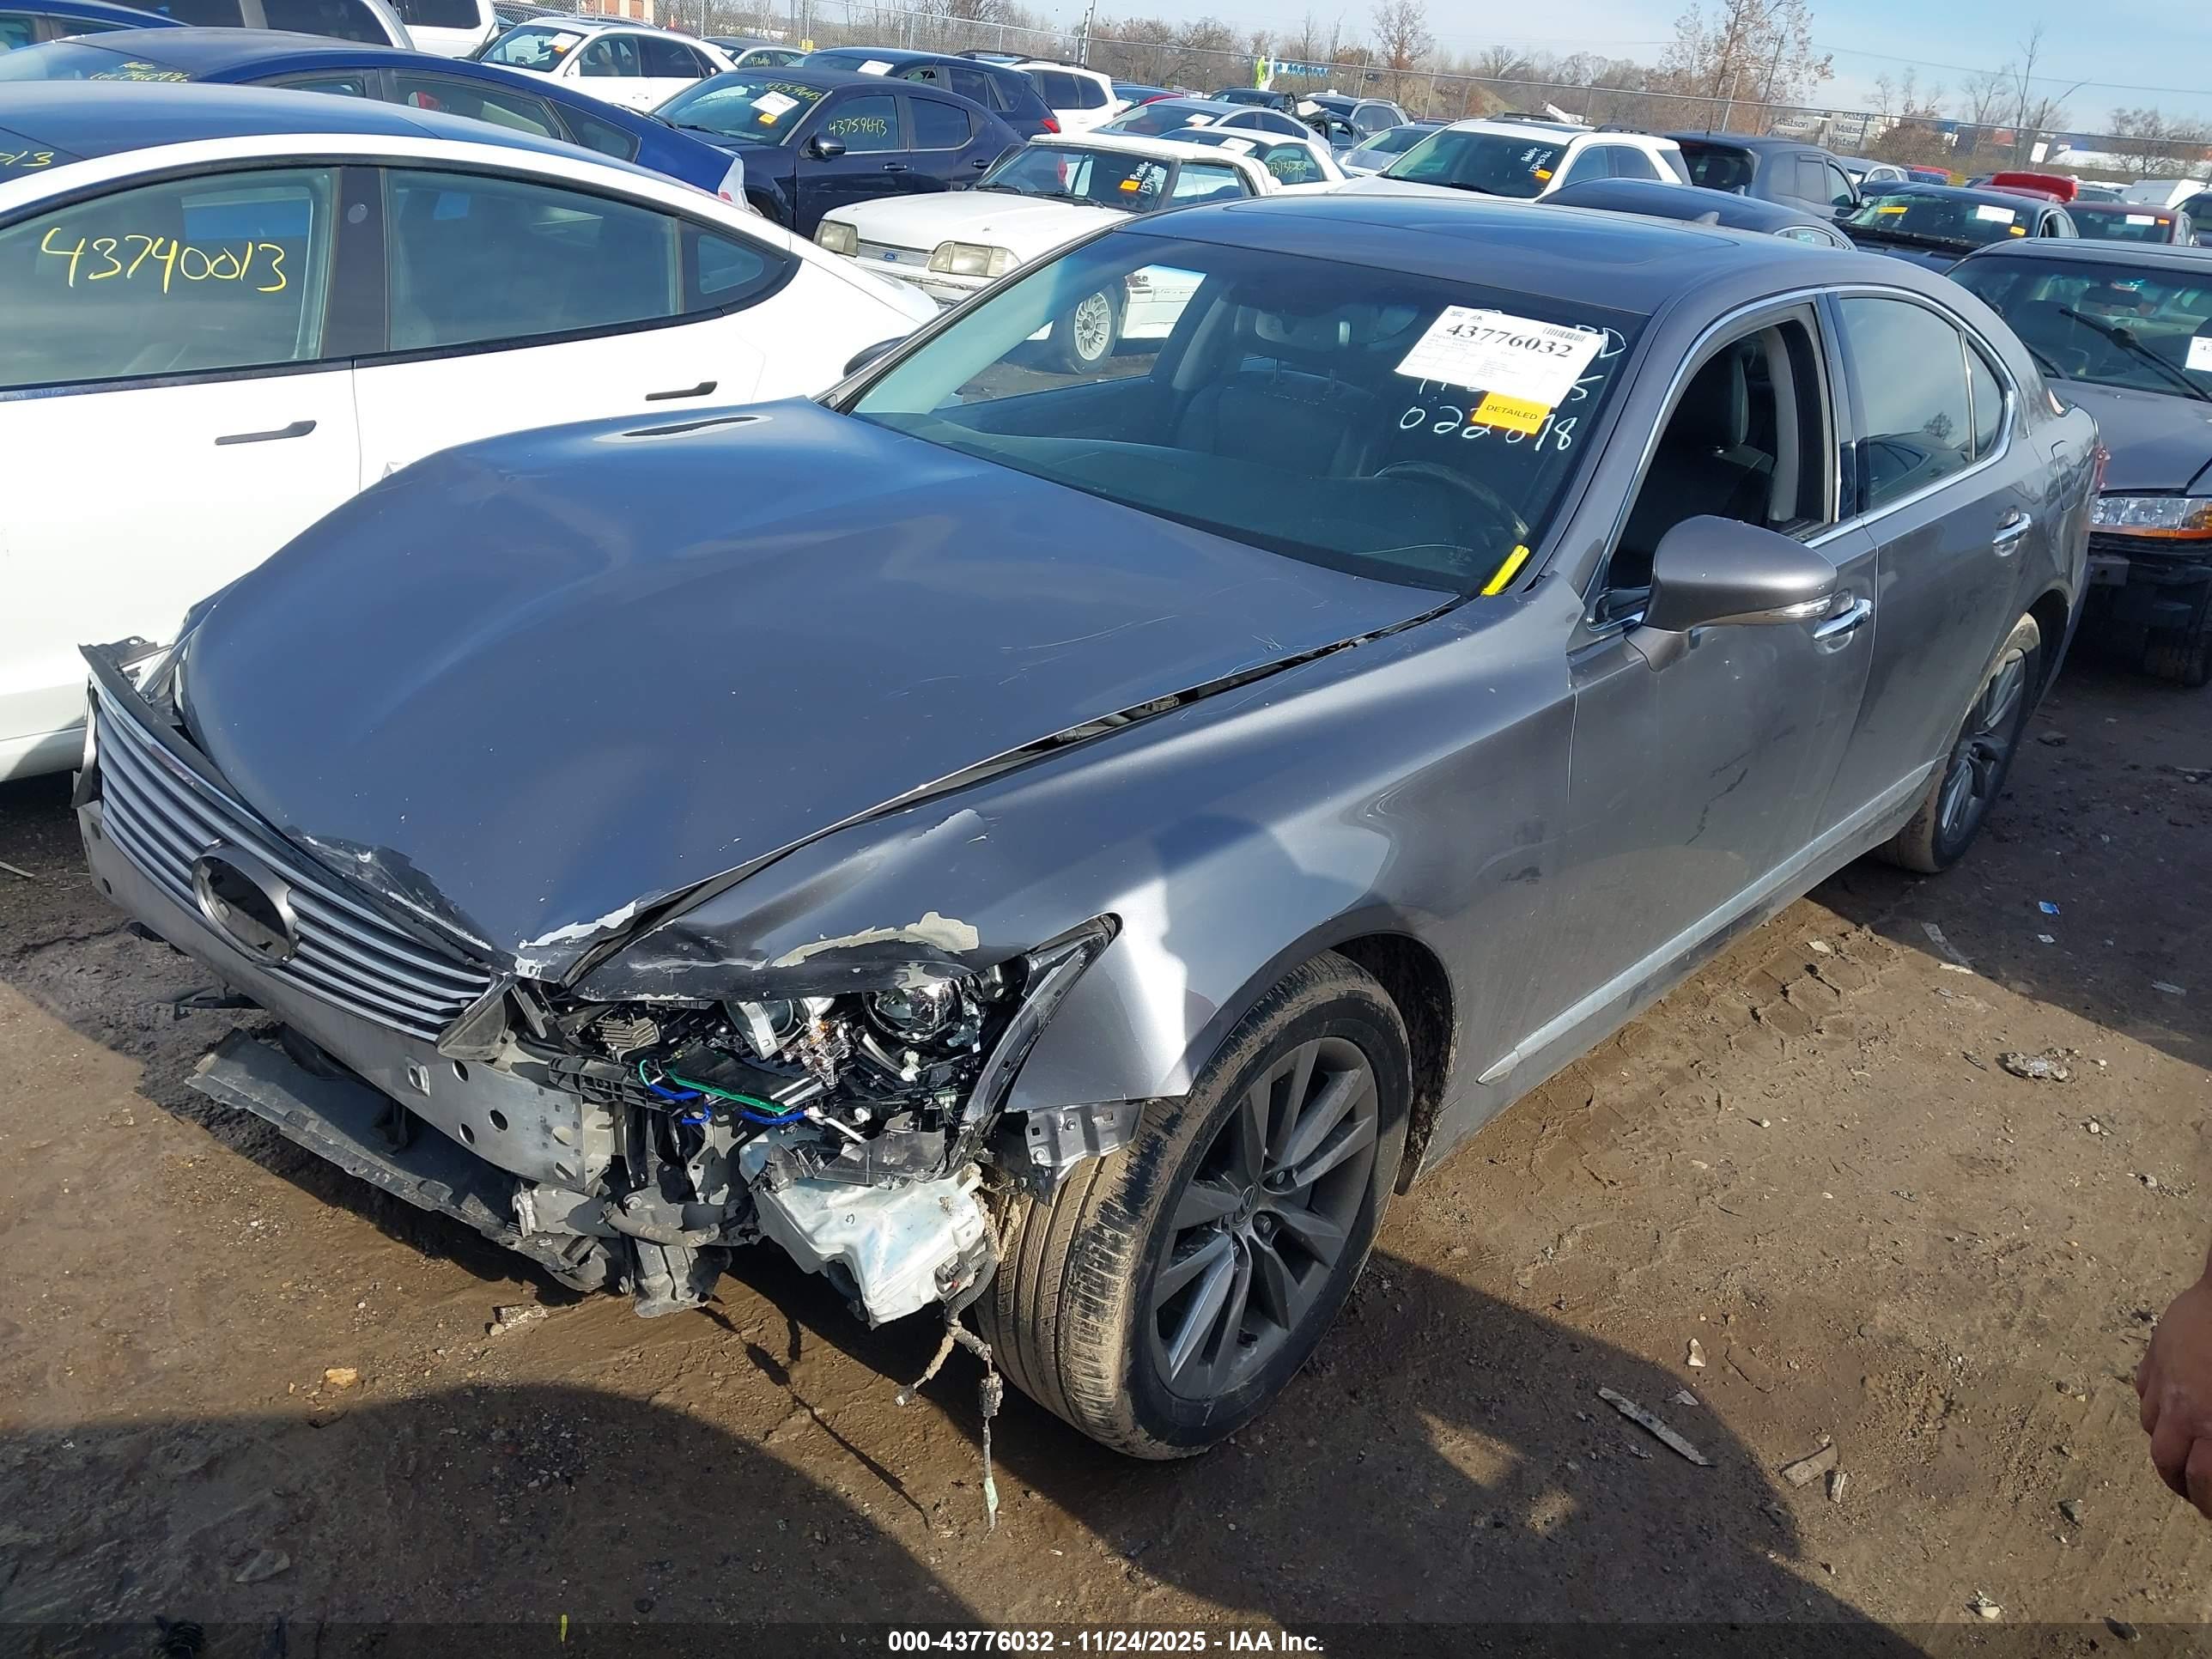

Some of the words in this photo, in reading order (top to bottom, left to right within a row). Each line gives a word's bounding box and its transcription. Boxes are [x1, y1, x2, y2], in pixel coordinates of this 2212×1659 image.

[829, 118, 887, 137] 43759643
[1836, 124, 1869, 136] Matson
[41, 228, 287, 294] 43740013
[1446, 324, 1573, 358] 43776032
[1486, 404, 1538, 422] DETAILED
